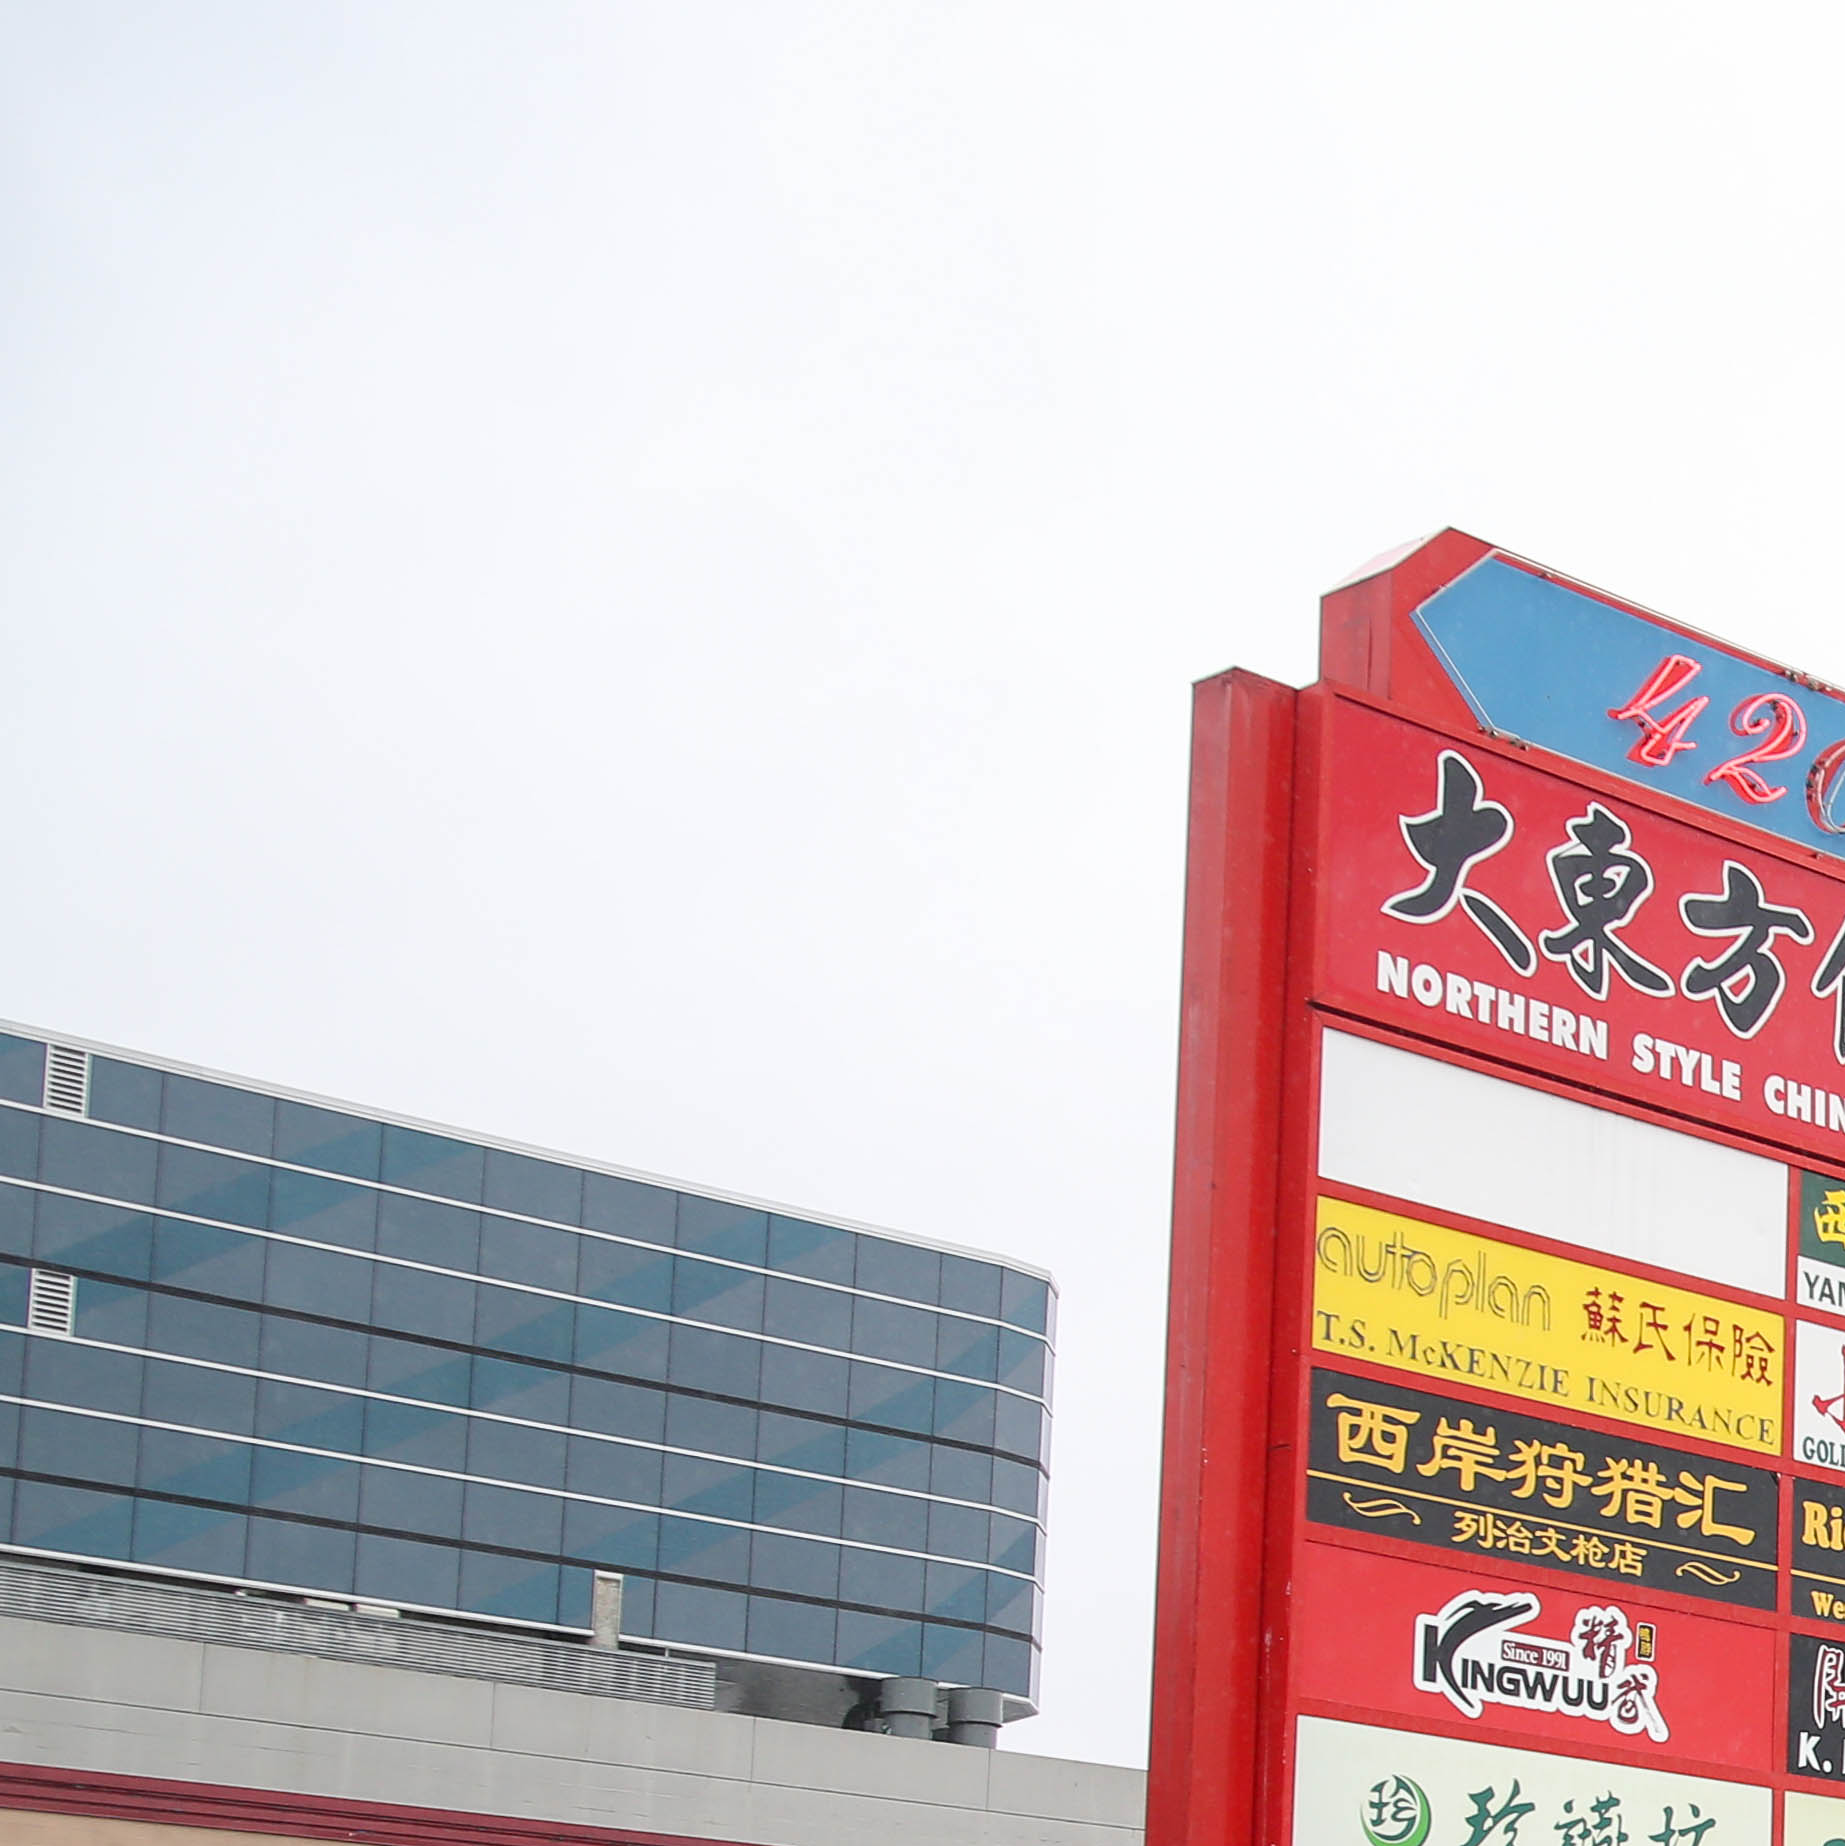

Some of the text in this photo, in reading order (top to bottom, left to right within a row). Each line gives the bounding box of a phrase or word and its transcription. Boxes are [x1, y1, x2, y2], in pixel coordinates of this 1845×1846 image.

[1377, 951, 1608, 1059] NORTHERN
[1632, 1023, 1741, 1102] STYLE
[1317, 1227, 1551, 1331] autoplan
[1317, 1311, 1776, 1445] T.S. McKENZIE INSURANCE
[1581, 1286, 1776, 1386] 蘇氏保險
[1327, 1394, 1756, 1545] 西岸狩猎汇
[1451, 1511, 1648, 1576] 列治文枪店
[1423, 1600, 1609, 1711] KINGWUU
[1503, 1642, 1567, 1669] Since 1991
